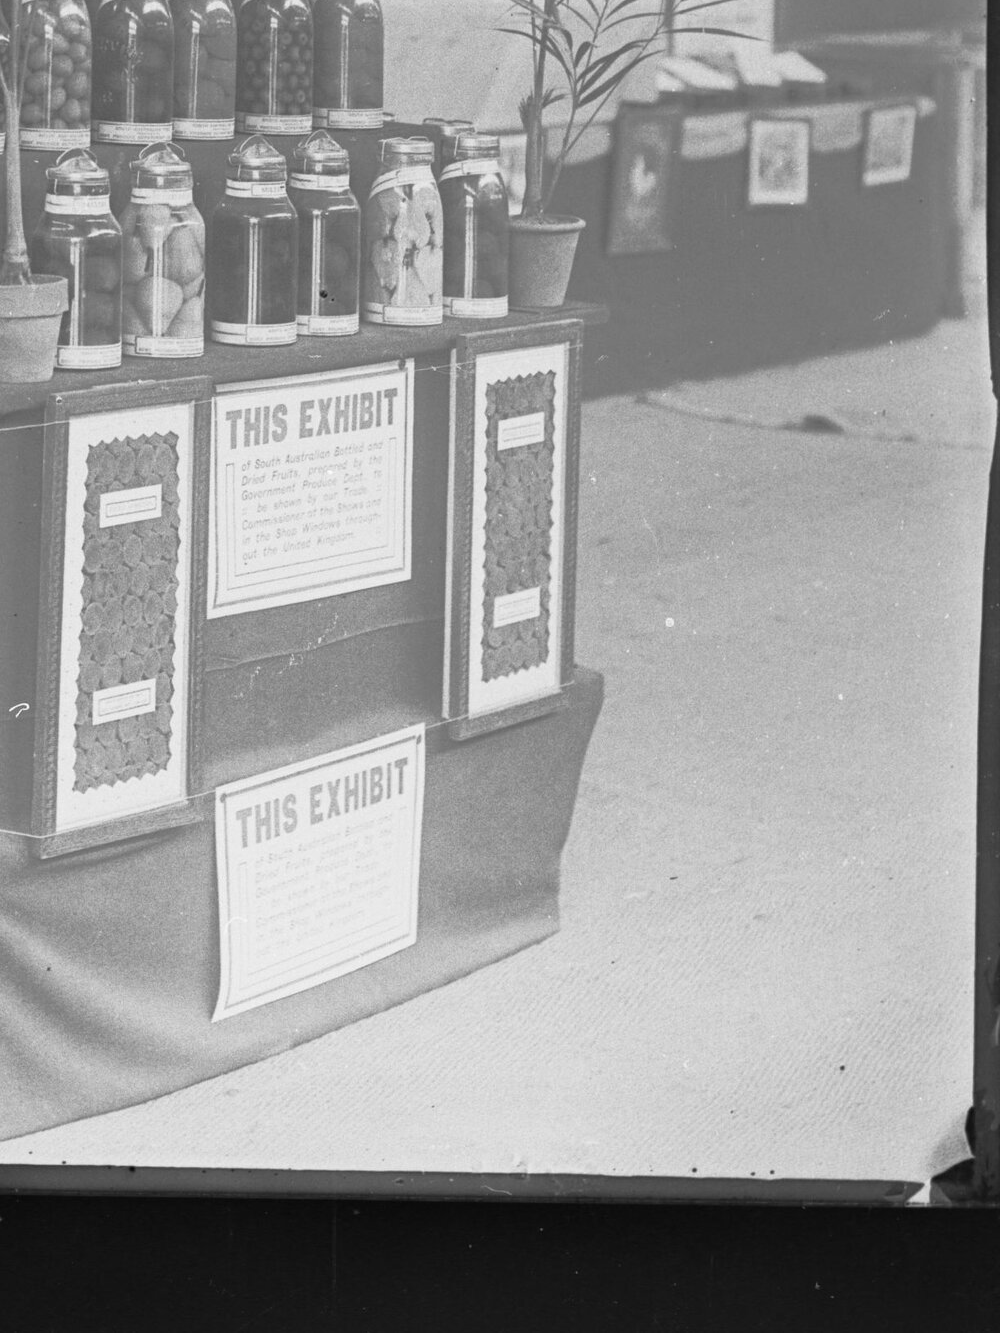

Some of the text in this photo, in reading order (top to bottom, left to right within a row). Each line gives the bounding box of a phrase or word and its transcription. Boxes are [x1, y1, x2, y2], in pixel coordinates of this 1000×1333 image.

[225, 388, 398, 450] THIS EXHIBIT
[235, 757, 408, 849] THIS EXHIBIT
